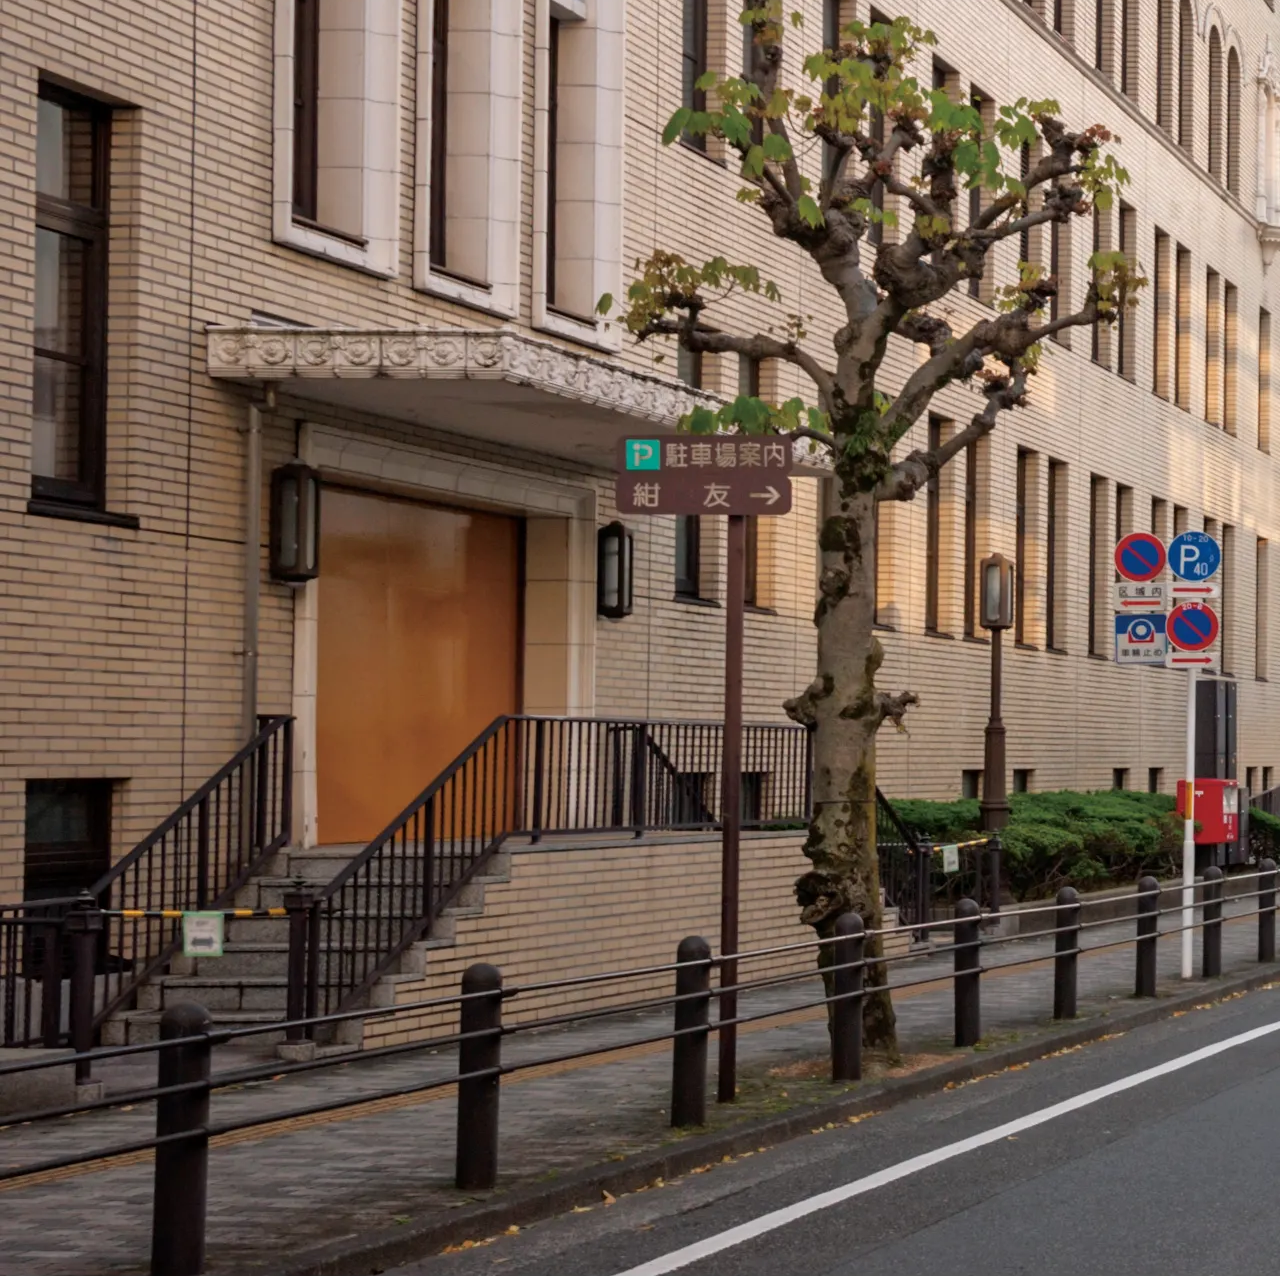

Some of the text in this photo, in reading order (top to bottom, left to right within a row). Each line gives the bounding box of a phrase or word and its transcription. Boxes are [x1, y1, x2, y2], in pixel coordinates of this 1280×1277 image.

[665, 441, 786, 469] 駐車場案内
[1179, 544, 1200, 576] P
[1118, 586, 1162, 598] 区域内
